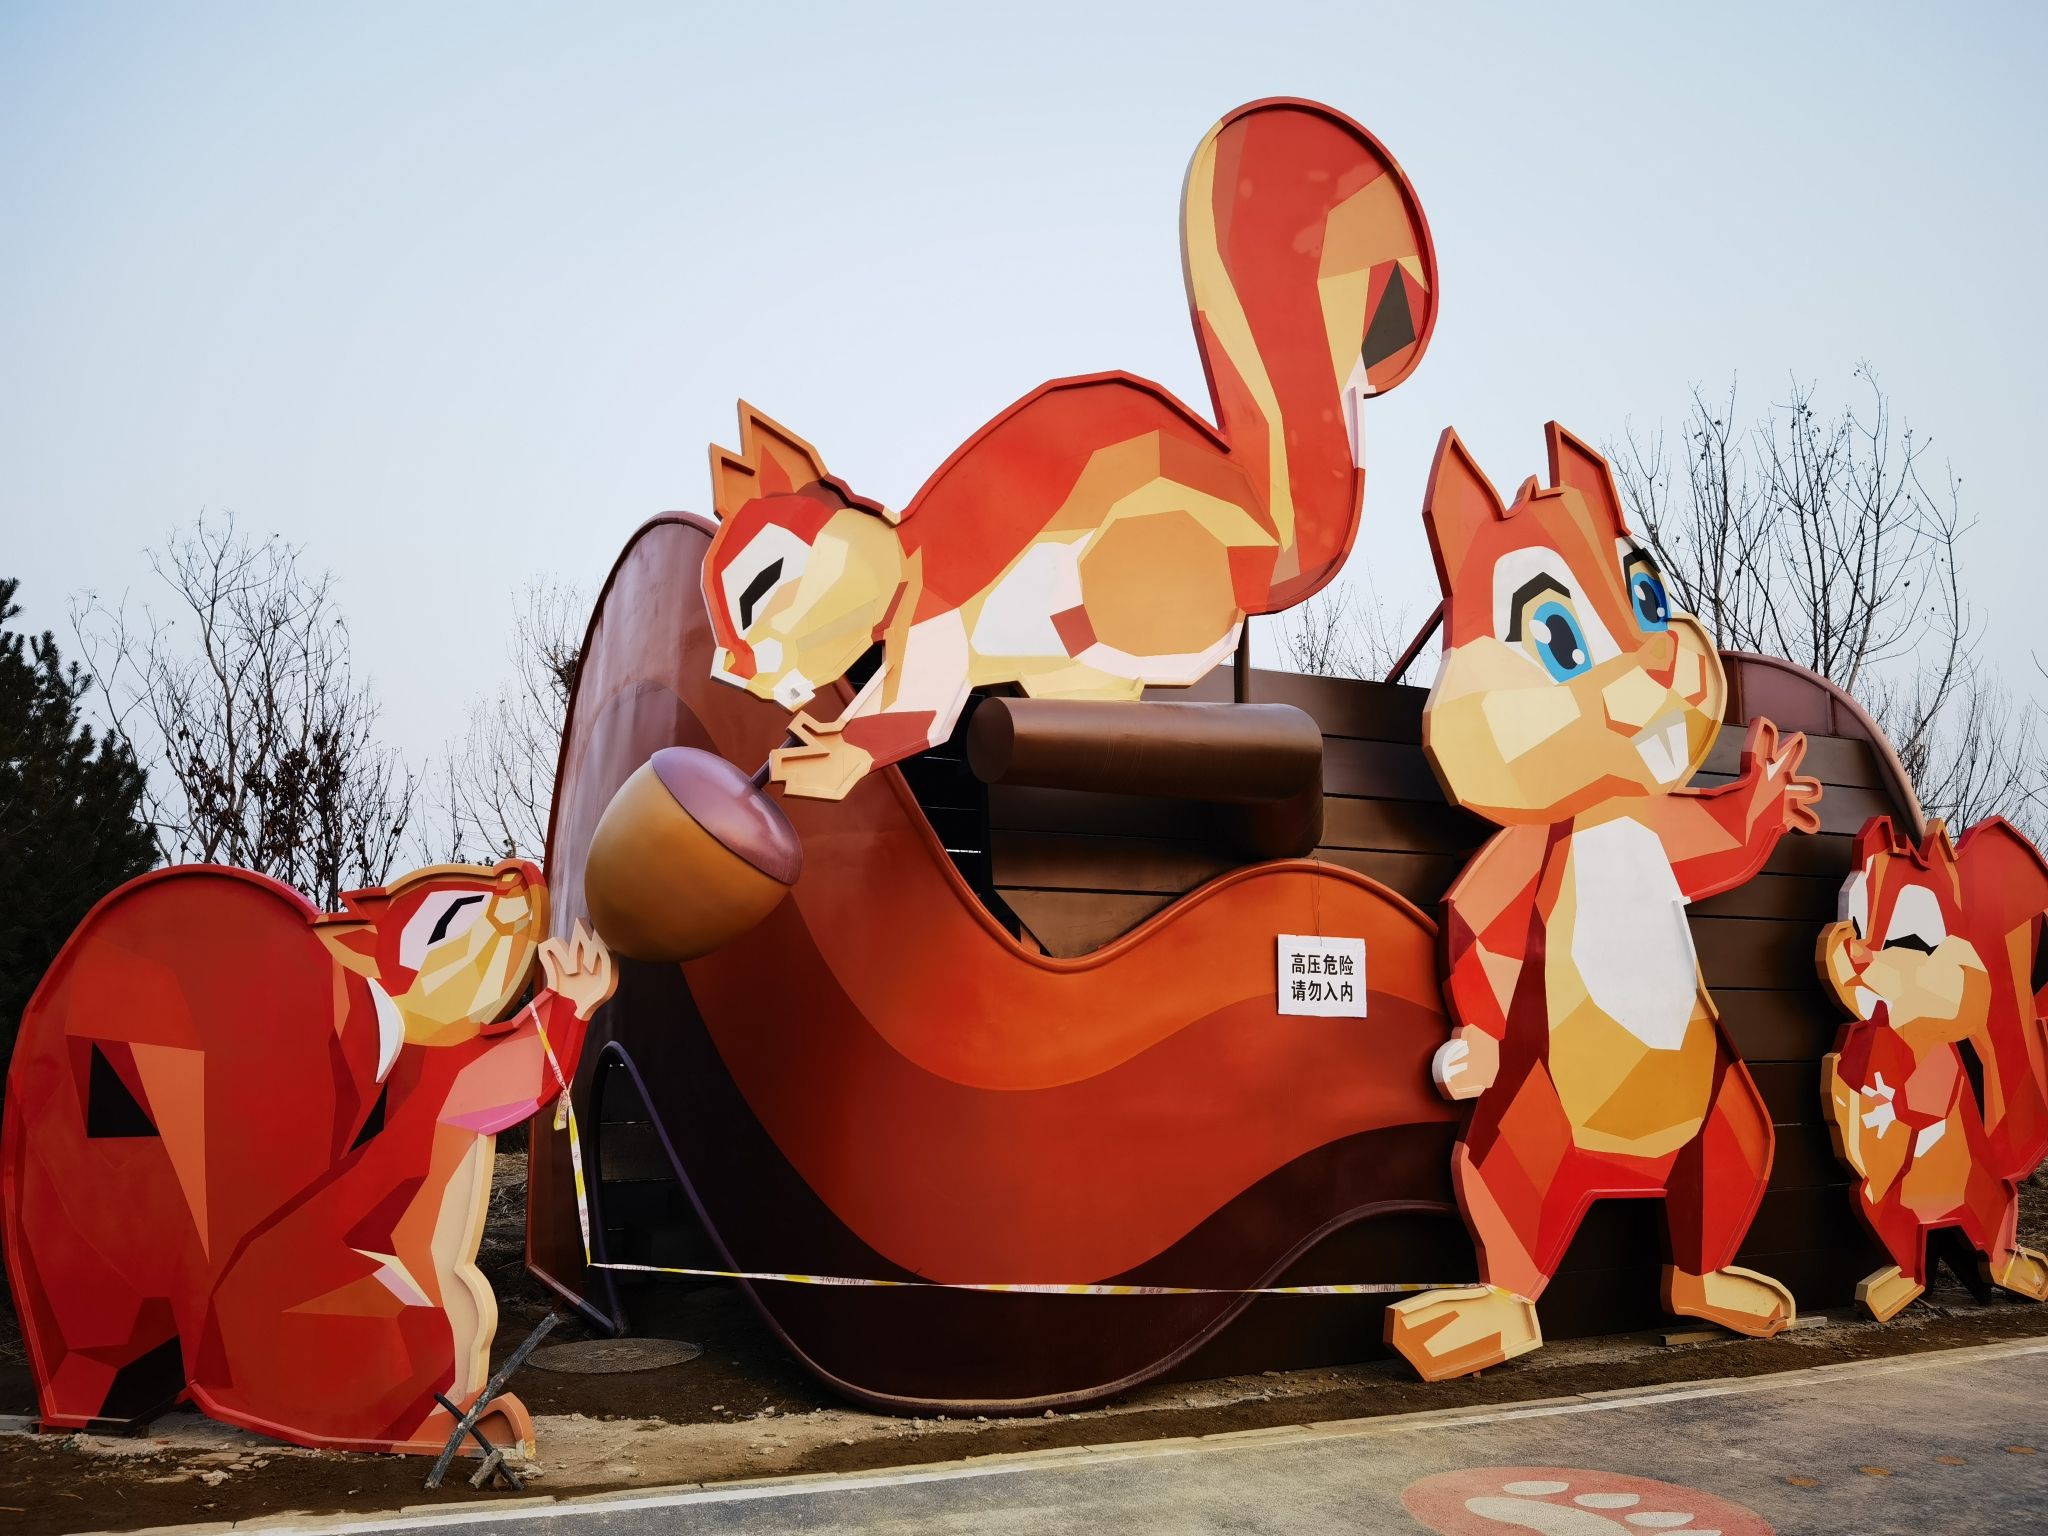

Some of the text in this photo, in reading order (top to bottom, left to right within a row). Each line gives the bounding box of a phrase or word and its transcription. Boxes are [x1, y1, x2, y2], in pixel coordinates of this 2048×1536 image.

[1291, 953, 1354, 975] 高压危险
[1291, 980, 1353, 1002] 请勿入内
